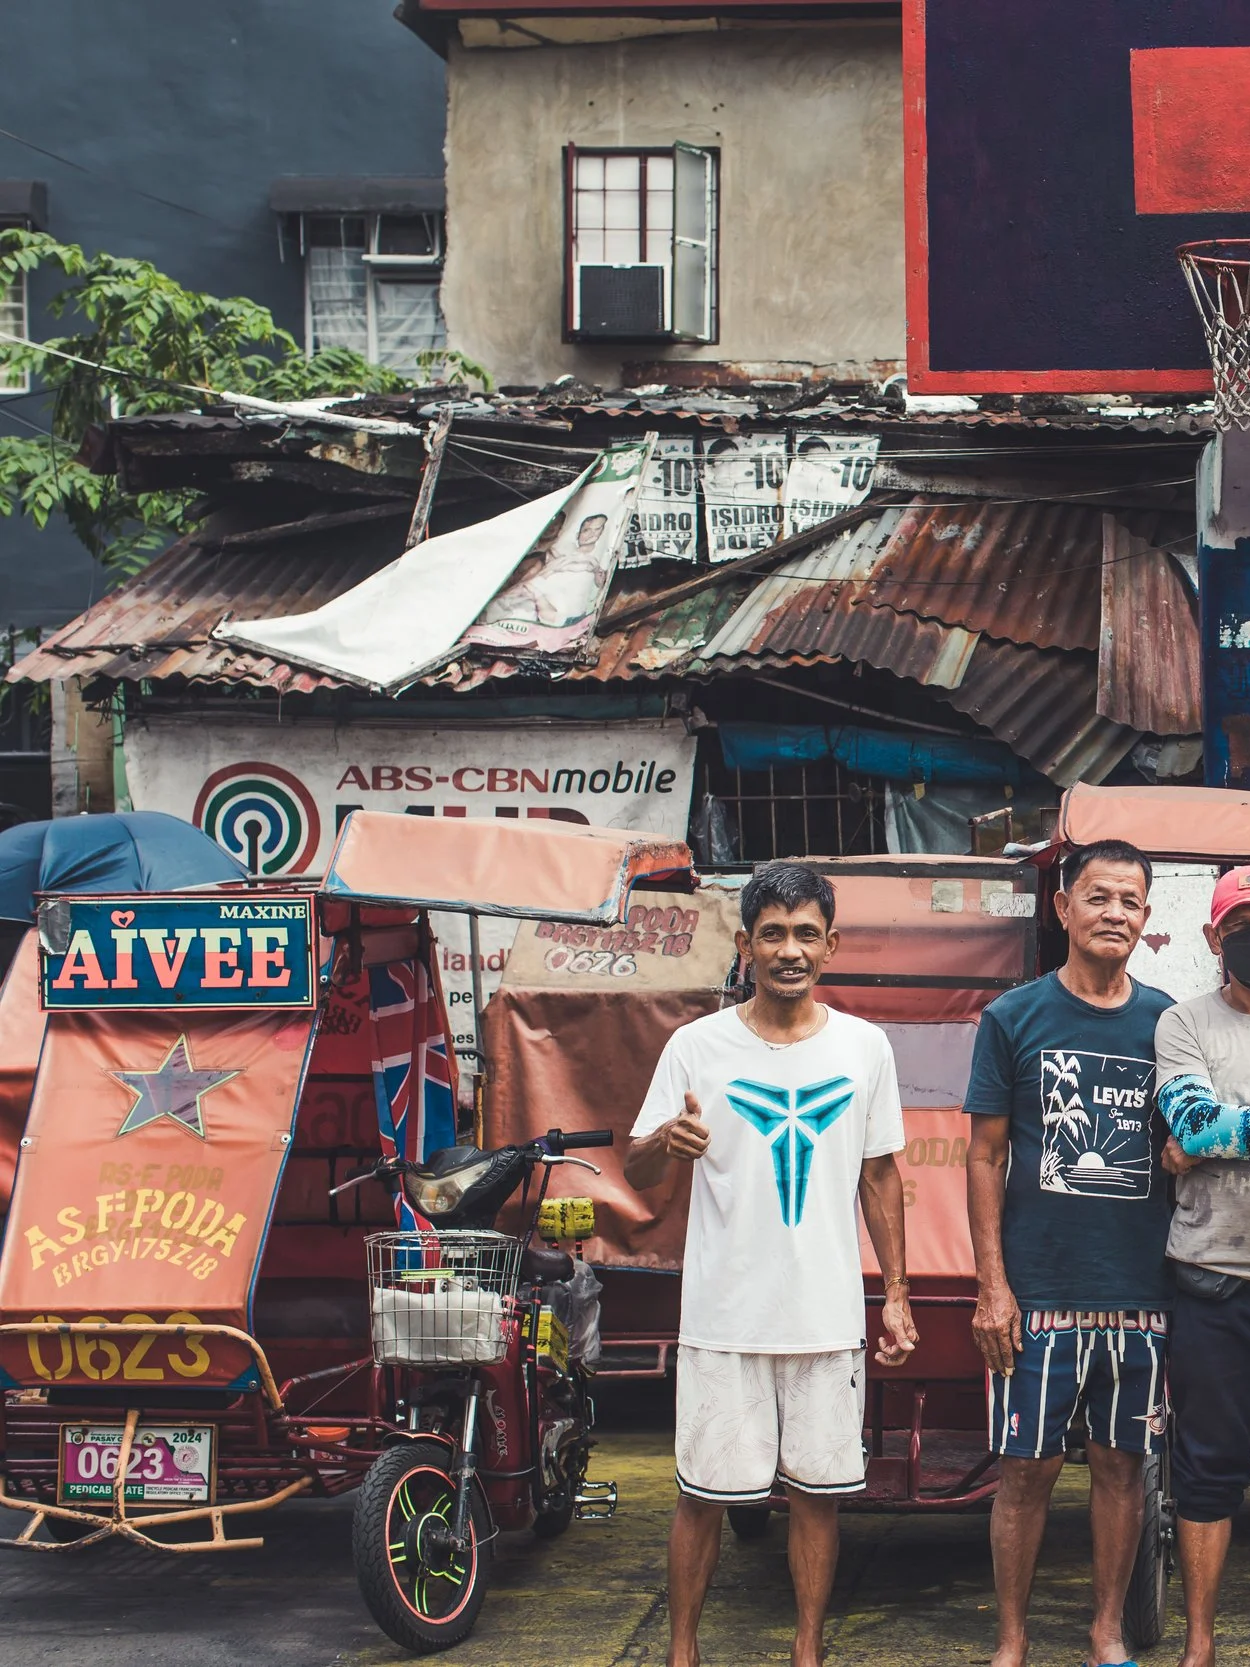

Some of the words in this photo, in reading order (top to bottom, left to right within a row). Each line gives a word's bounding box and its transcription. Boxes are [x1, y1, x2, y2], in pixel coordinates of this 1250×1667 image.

[658, 458, 694, 497] 10
[749, 452, 785, 490] 10
[839, 456, 876, 491] 10
[630, 512, 692, 533] SIDRO
[711, 505, 785, 527] ISIDRO
[219, 905, 306, 920] MAXINE
[625, 904, 700, 933] PODA
[52, 926, 292, 989] AIVEE
[544, 946, 637, 978] 0626
[1116, 1118, 1142, 1132] 1873
[894, 1136, 967, 1167] ODA
[27, 1311, 211, 1381] 0623
[173, 1432, 203, 1443] 2024
[77, 1446, 164, 1479] 0623
[70, 1484, 113, 1494] PEDICAB
